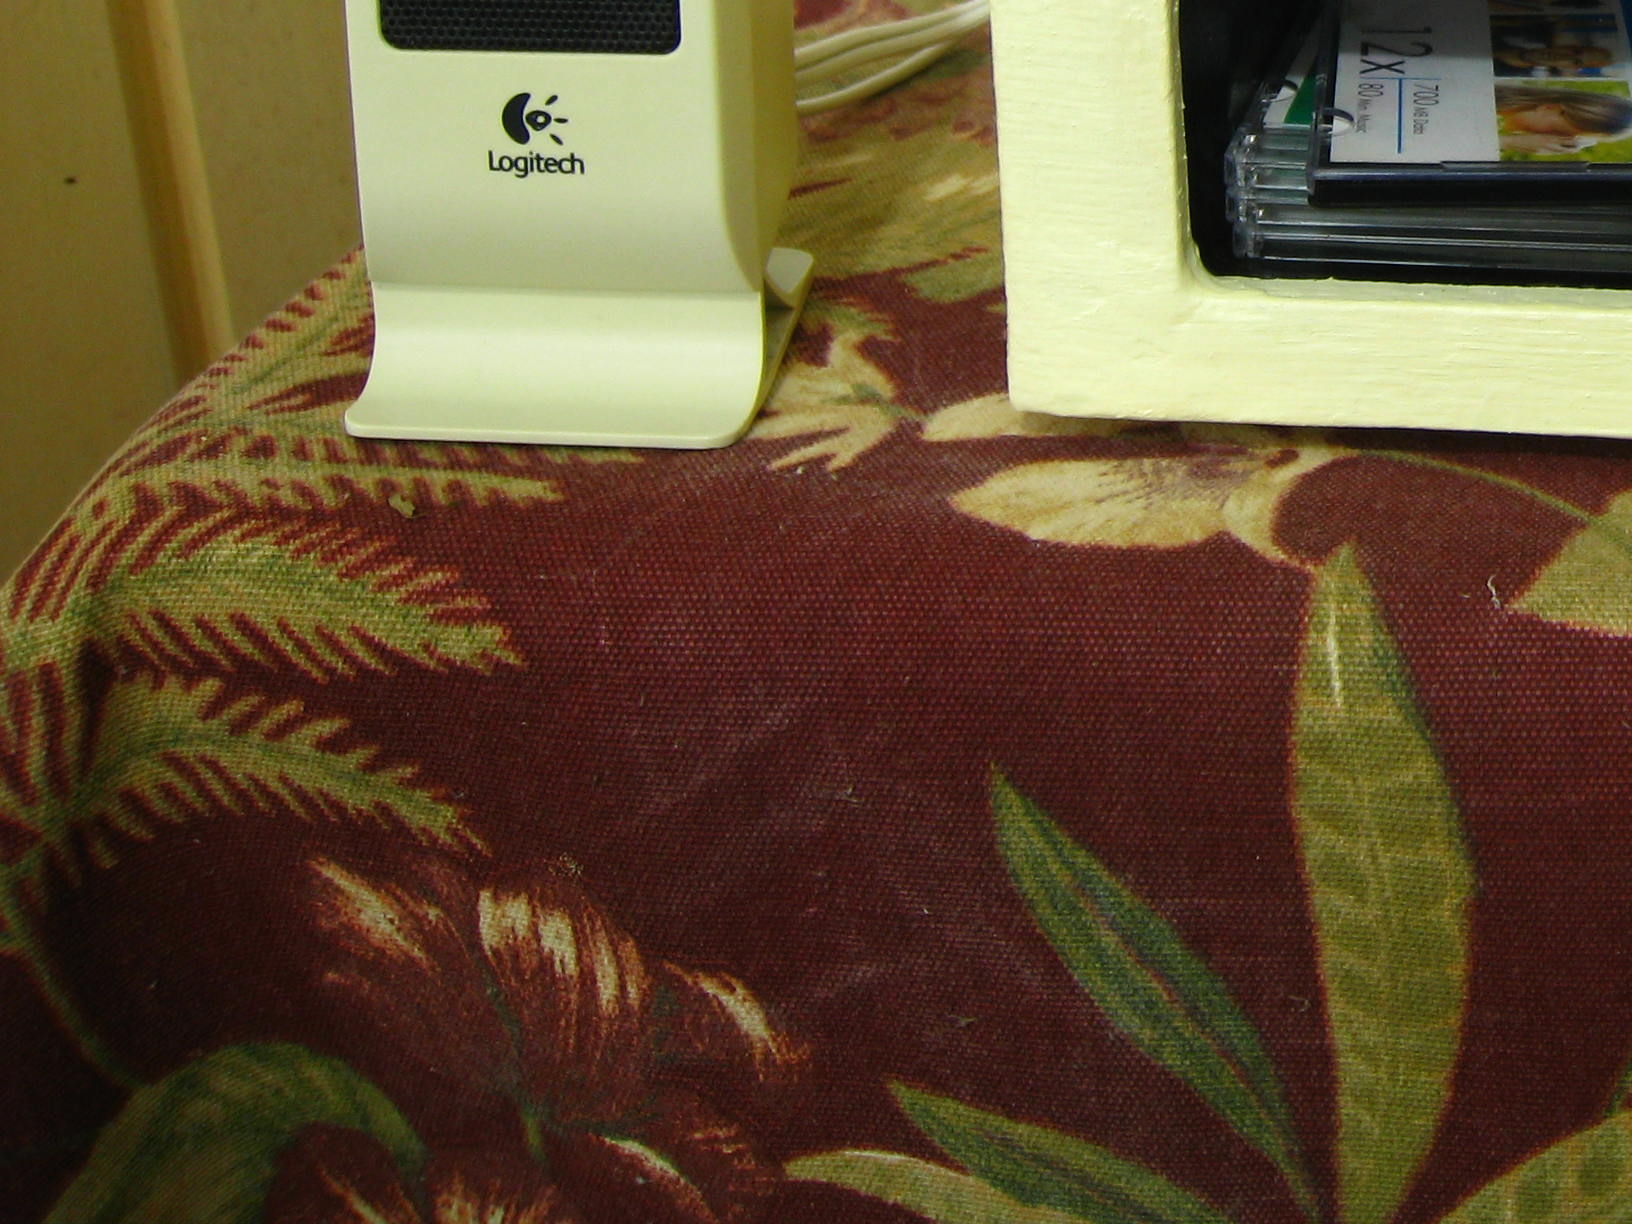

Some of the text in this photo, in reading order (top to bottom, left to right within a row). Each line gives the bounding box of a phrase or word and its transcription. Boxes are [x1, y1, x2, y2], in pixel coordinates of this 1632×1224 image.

[1358, 83, 1384, 96] 80
[1413, 84, 1440, 105] 700
[487, 150, 585, 178] Logitech
